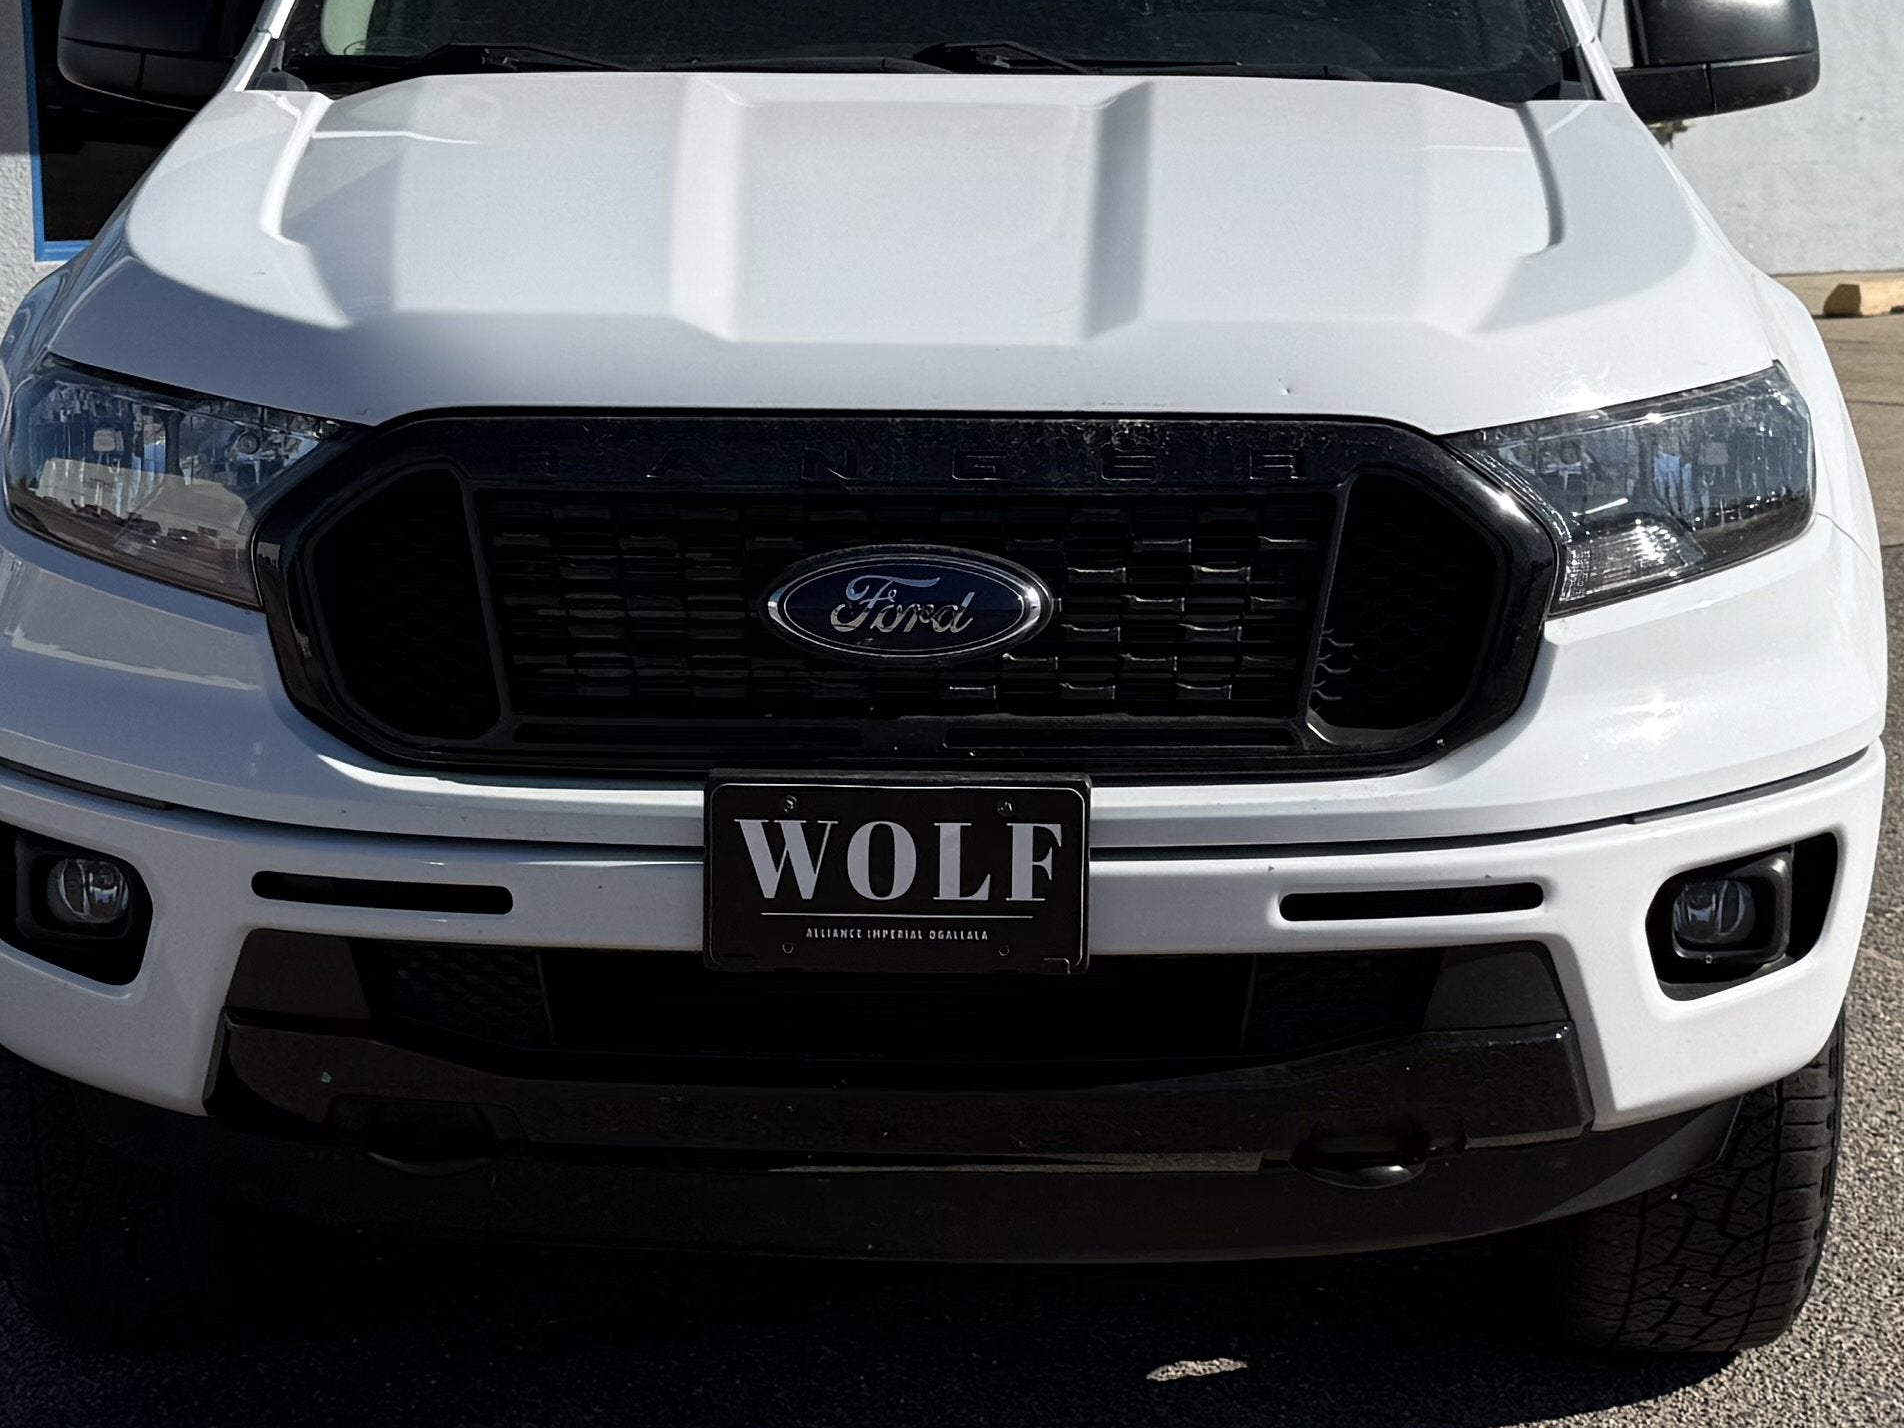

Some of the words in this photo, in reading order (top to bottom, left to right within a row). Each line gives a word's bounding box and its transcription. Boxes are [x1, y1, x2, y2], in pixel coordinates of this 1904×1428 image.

[830, 574, 975, 633] Ford
[733, 818, 1063, 902] WOLF
[805, 927, 862, 939] ALLIANCE
[866, 928, 923, 940] IMPERIAL
[928, 929, 989, 941] OGALLALA
